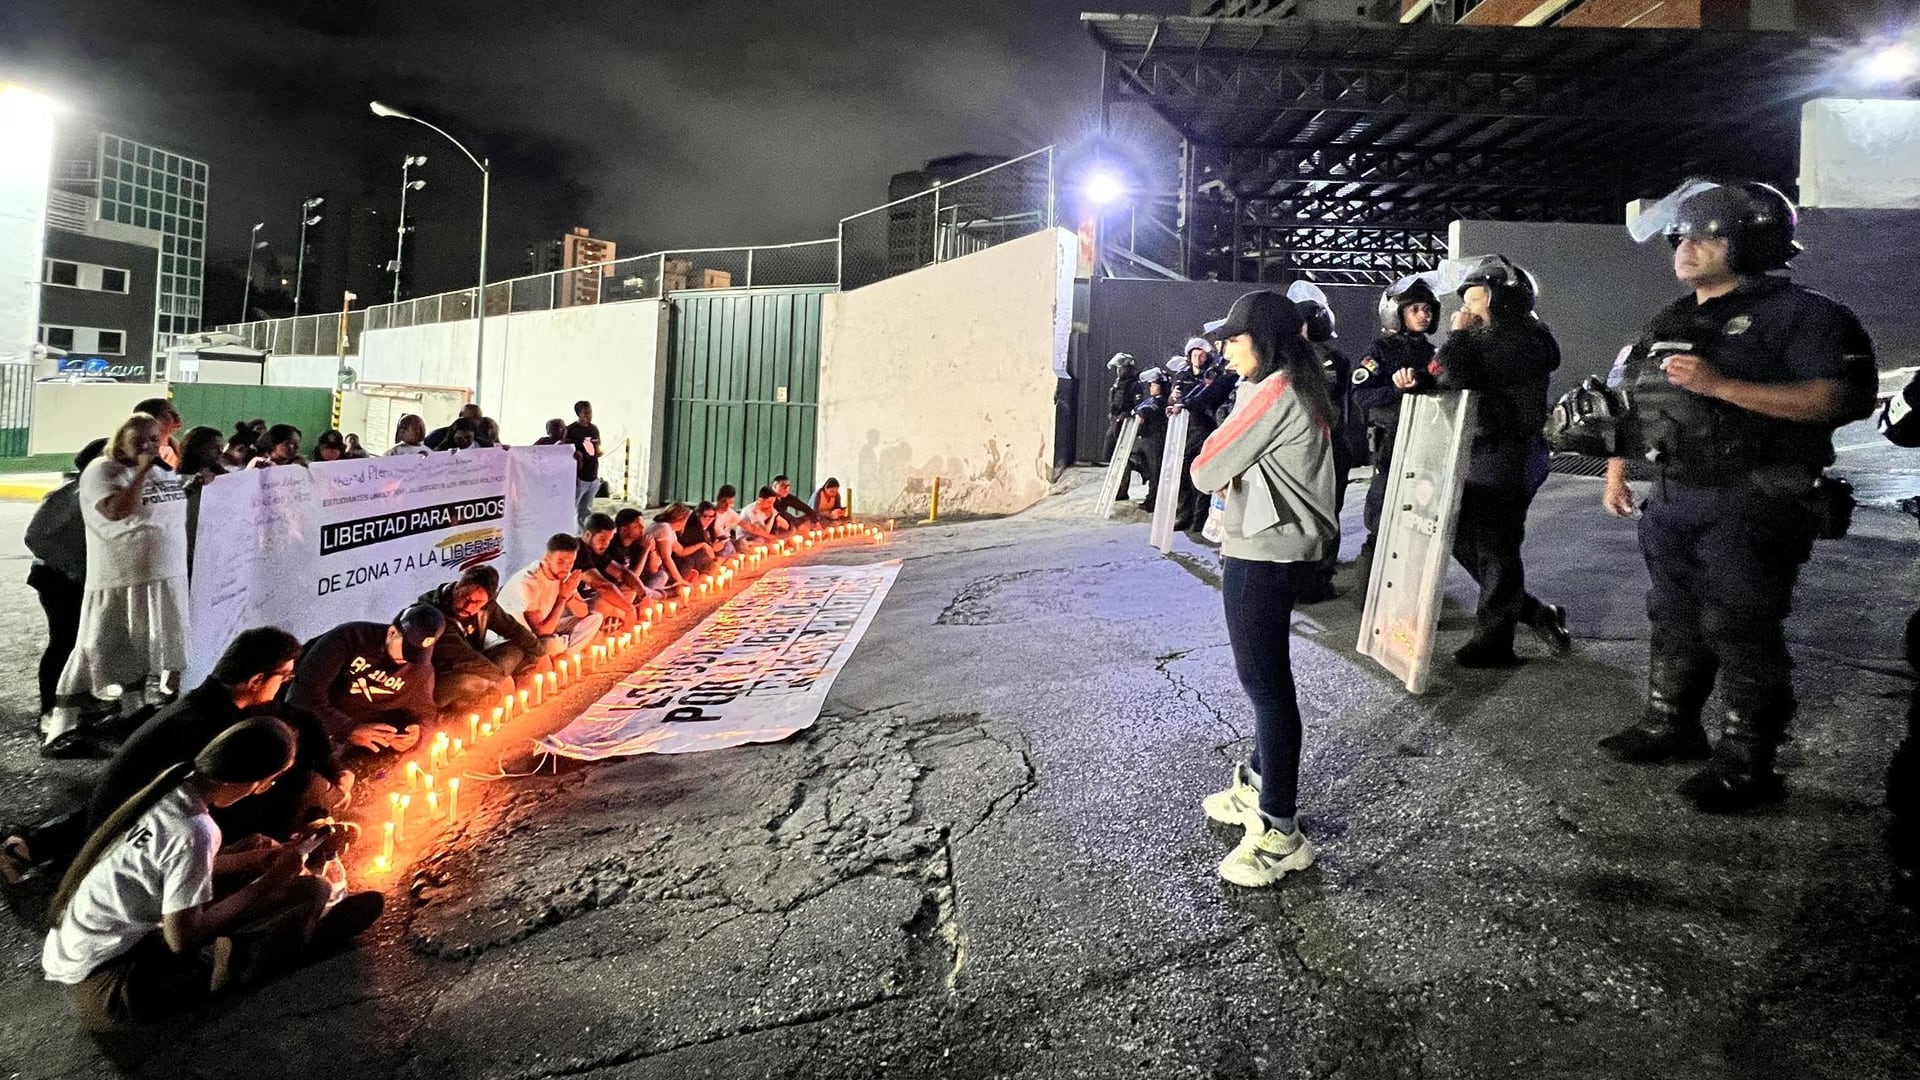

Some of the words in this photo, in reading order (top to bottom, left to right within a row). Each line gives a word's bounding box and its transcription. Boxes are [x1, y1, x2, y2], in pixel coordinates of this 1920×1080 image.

[322, 516, 408, 550] LIBERTAD
[410, 507, 452, 532] PARA
[454, 498, 505, 522] TODOS
[318, 573, 342, 596] DE
[345, 562, 390, 589] ZONA
[394, 558, 402, 575] 7
[405, 556, 416, 573] A
[419, 550, 438, 568] LA
